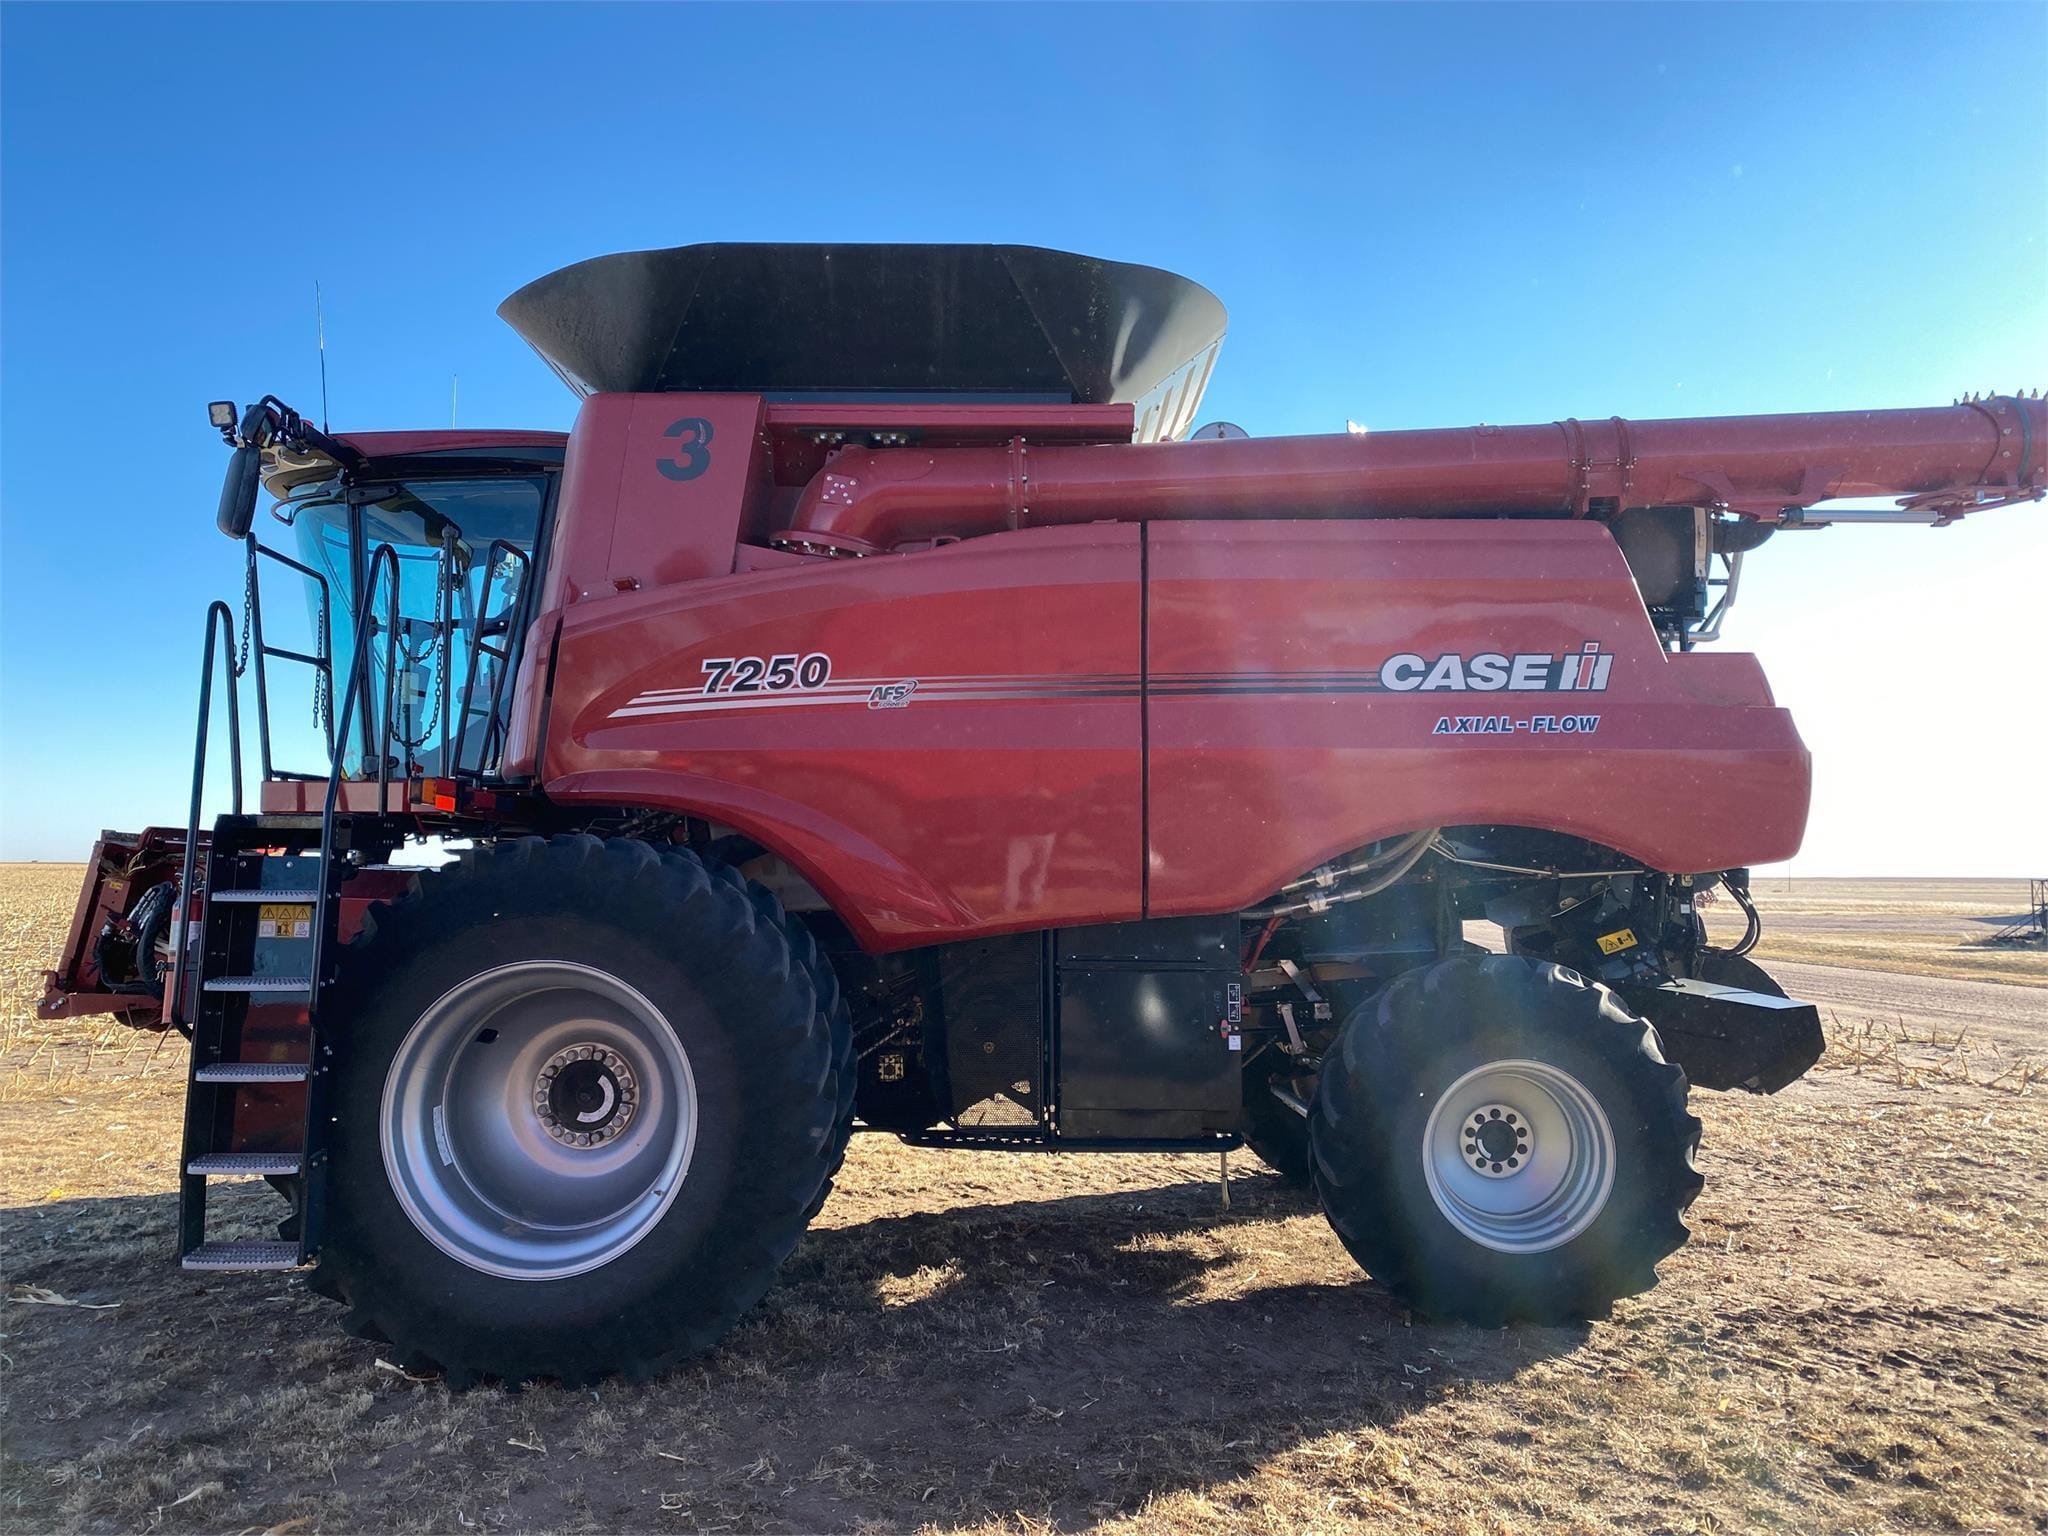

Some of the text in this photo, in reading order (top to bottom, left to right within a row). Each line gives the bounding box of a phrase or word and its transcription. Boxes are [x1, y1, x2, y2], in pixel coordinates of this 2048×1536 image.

[655, 417, 715, 482] 3
[701, 652, 832, 694] 7250
[1379, 652, 1553, 692] CASE
[869, 684, 908, 701] AFS
[1432, 714, 1601, 735] AXIAL-FLOW
